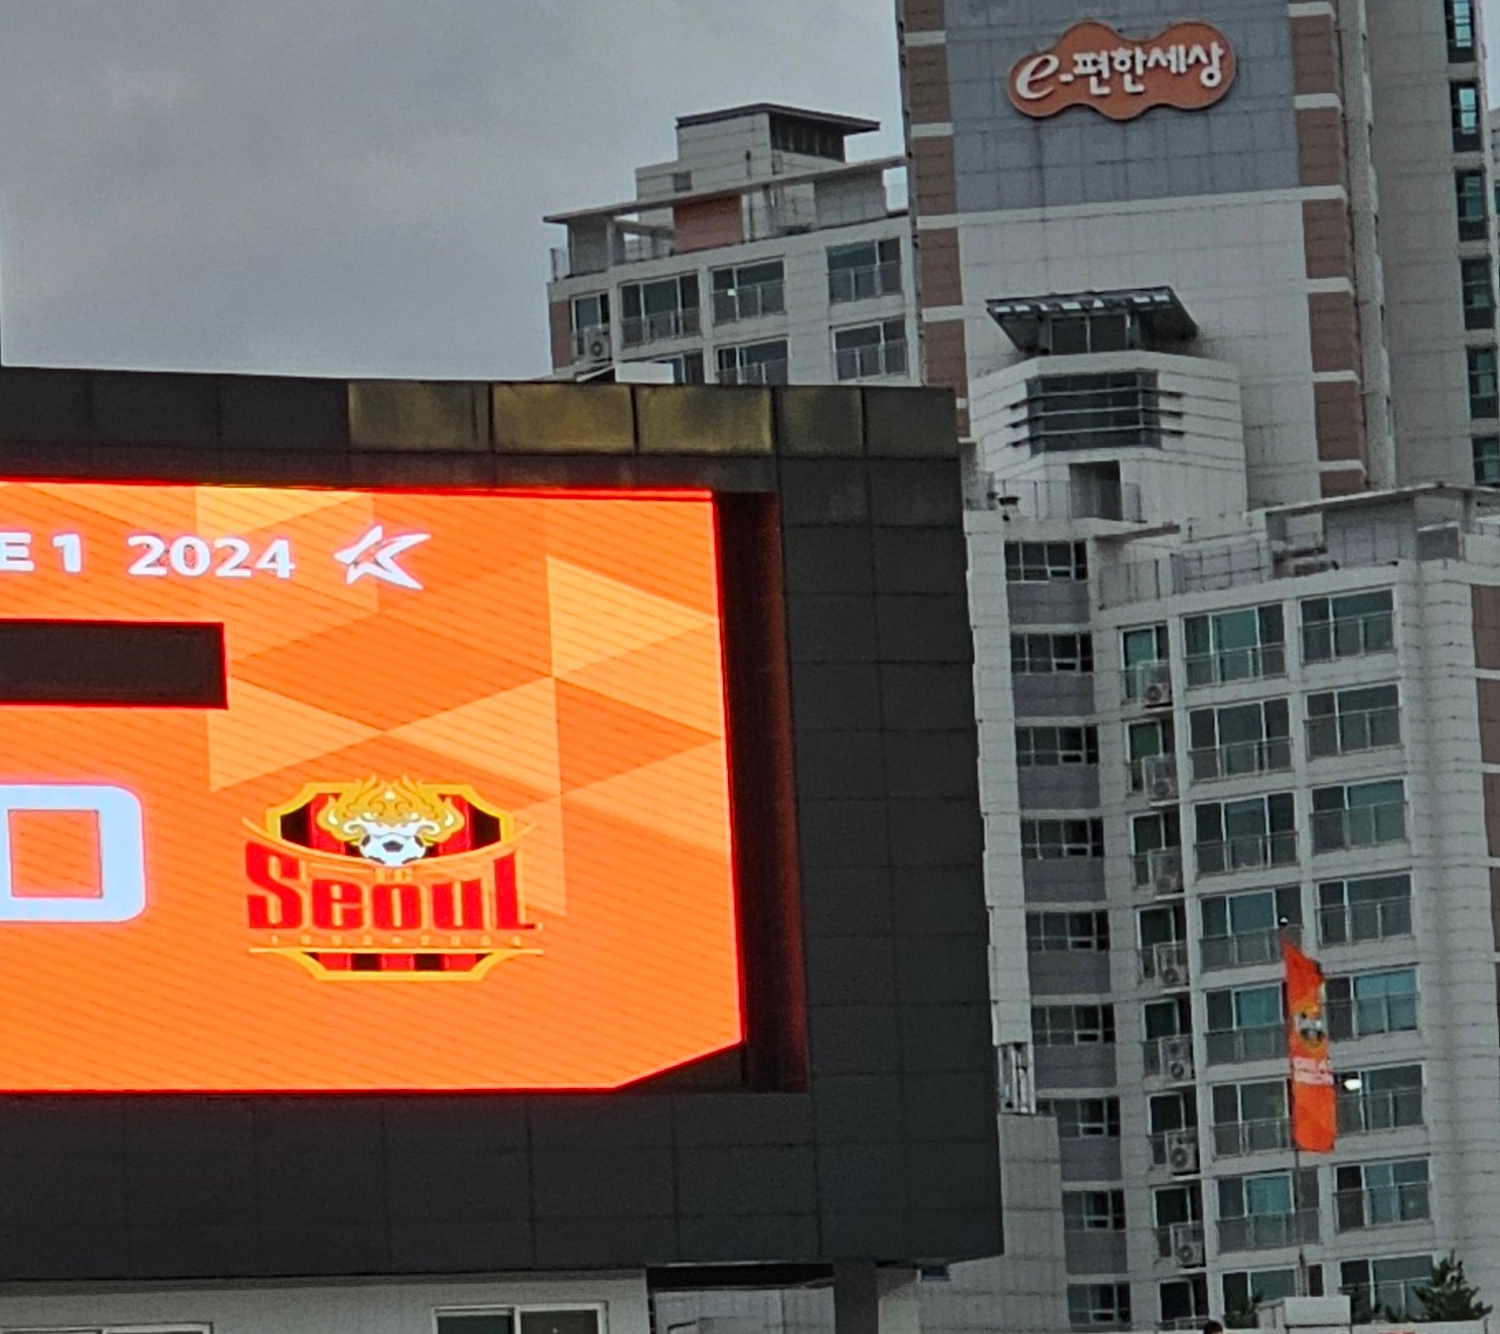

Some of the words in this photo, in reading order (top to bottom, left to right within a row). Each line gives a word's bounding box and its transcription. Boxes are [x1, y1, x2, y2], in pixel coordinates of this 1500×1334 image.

[1015, 41, 1224, 99] e-편한세상
[52, 533, 83, 573] 1
[127, 534, 297, 579] 2024
[246, 841, 536, 930] Seoul
